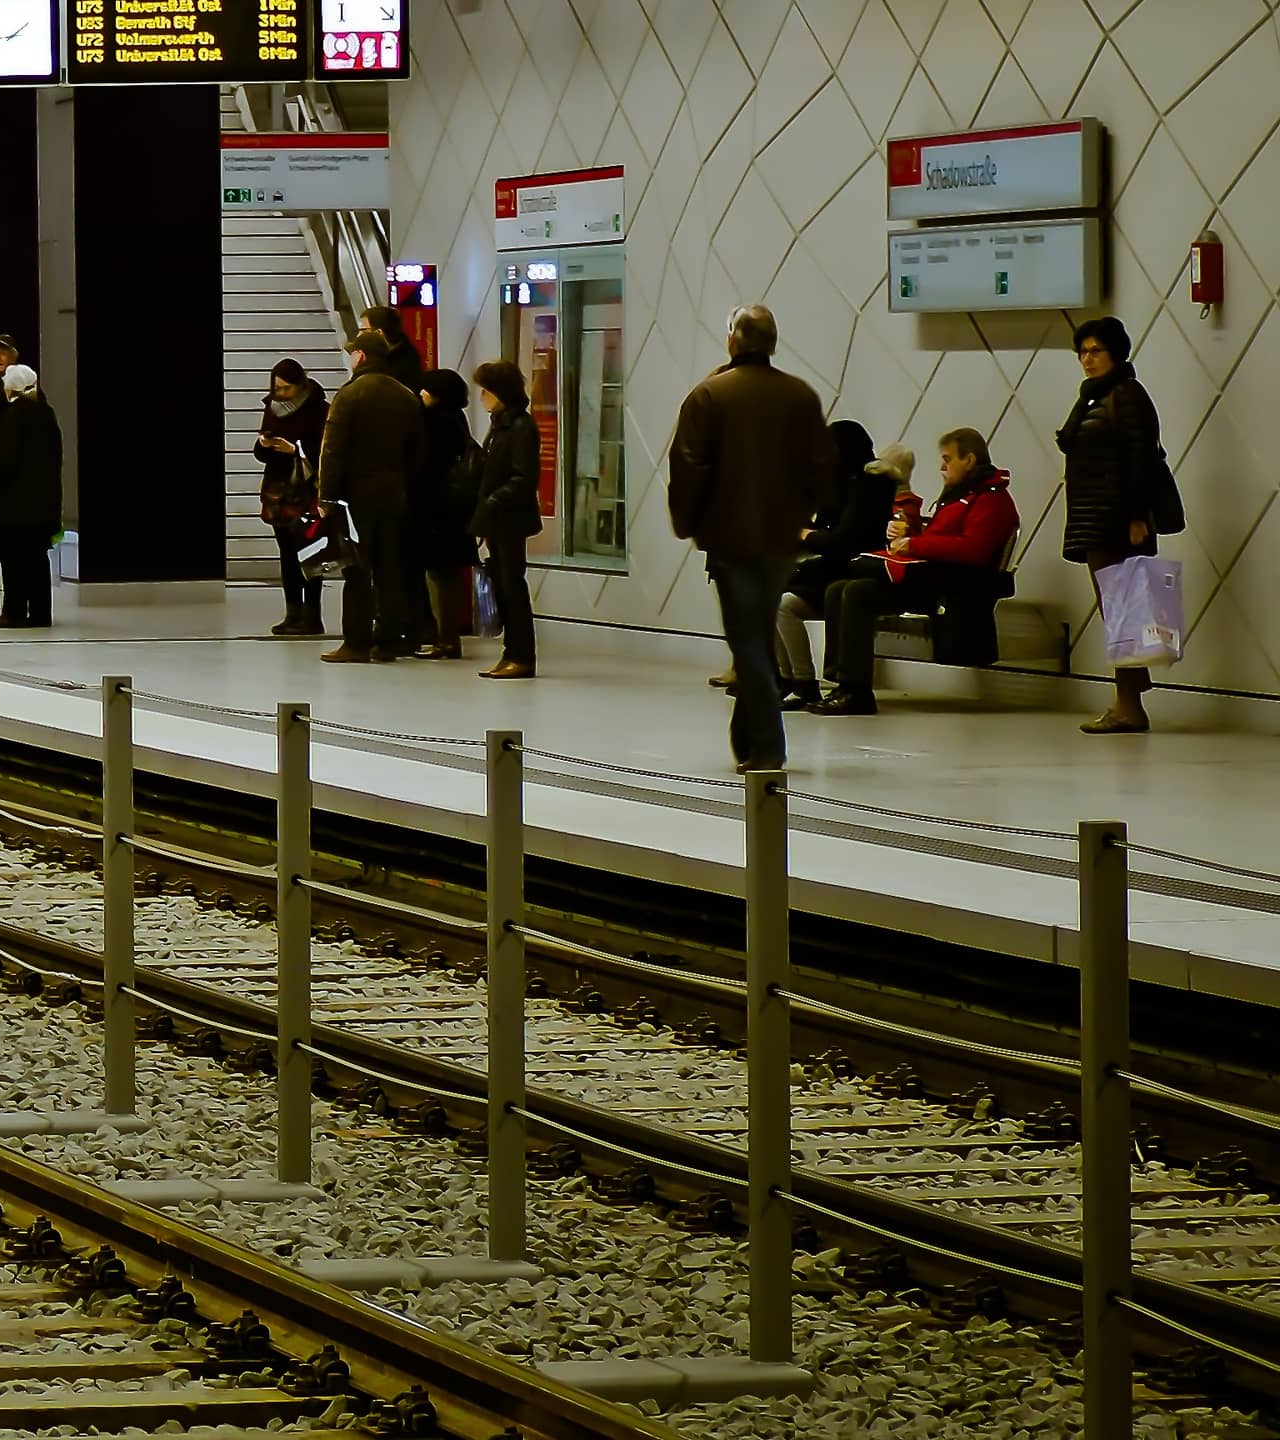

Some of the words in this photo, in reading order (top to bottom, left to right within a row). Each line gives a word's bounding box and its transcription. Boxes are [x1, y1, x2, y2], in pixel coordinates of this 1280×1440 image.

[76, 0, 104, 14] U73
[76, 32, 104, 47] U72
[76, 49, 104, 64] U73
[926, 154, 998, 192] Schadowstraße
